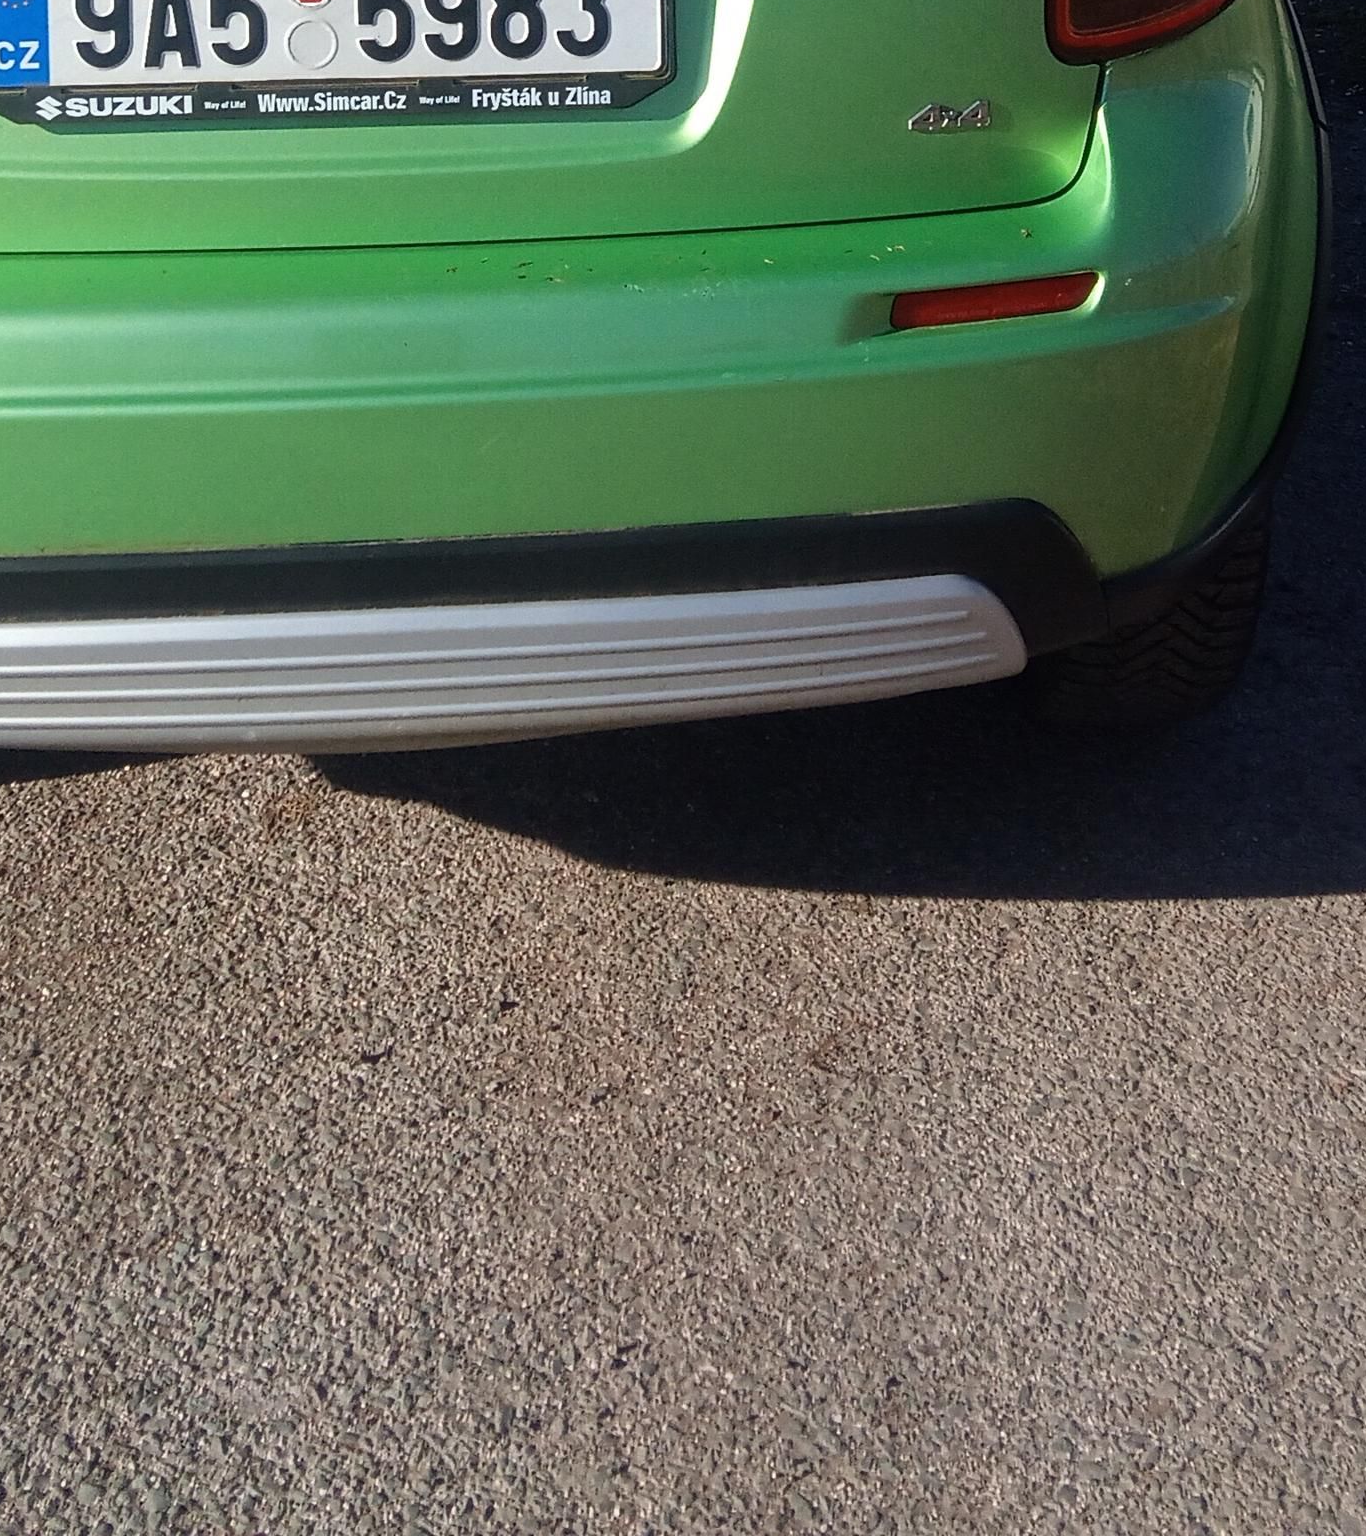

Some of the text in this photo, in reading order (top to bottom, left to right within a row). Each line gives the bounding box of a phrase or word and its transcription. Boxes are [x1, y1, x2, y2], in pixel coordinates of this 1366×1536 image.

[65, 95, 193, 115] SUZUKI
[258, 91, 406, 113] Www.Simcar.Cz
[471, 87, 542, 110] Fryšták
[548, 90, 559, 106] u
[565, 86, 611, 106] Zlína
